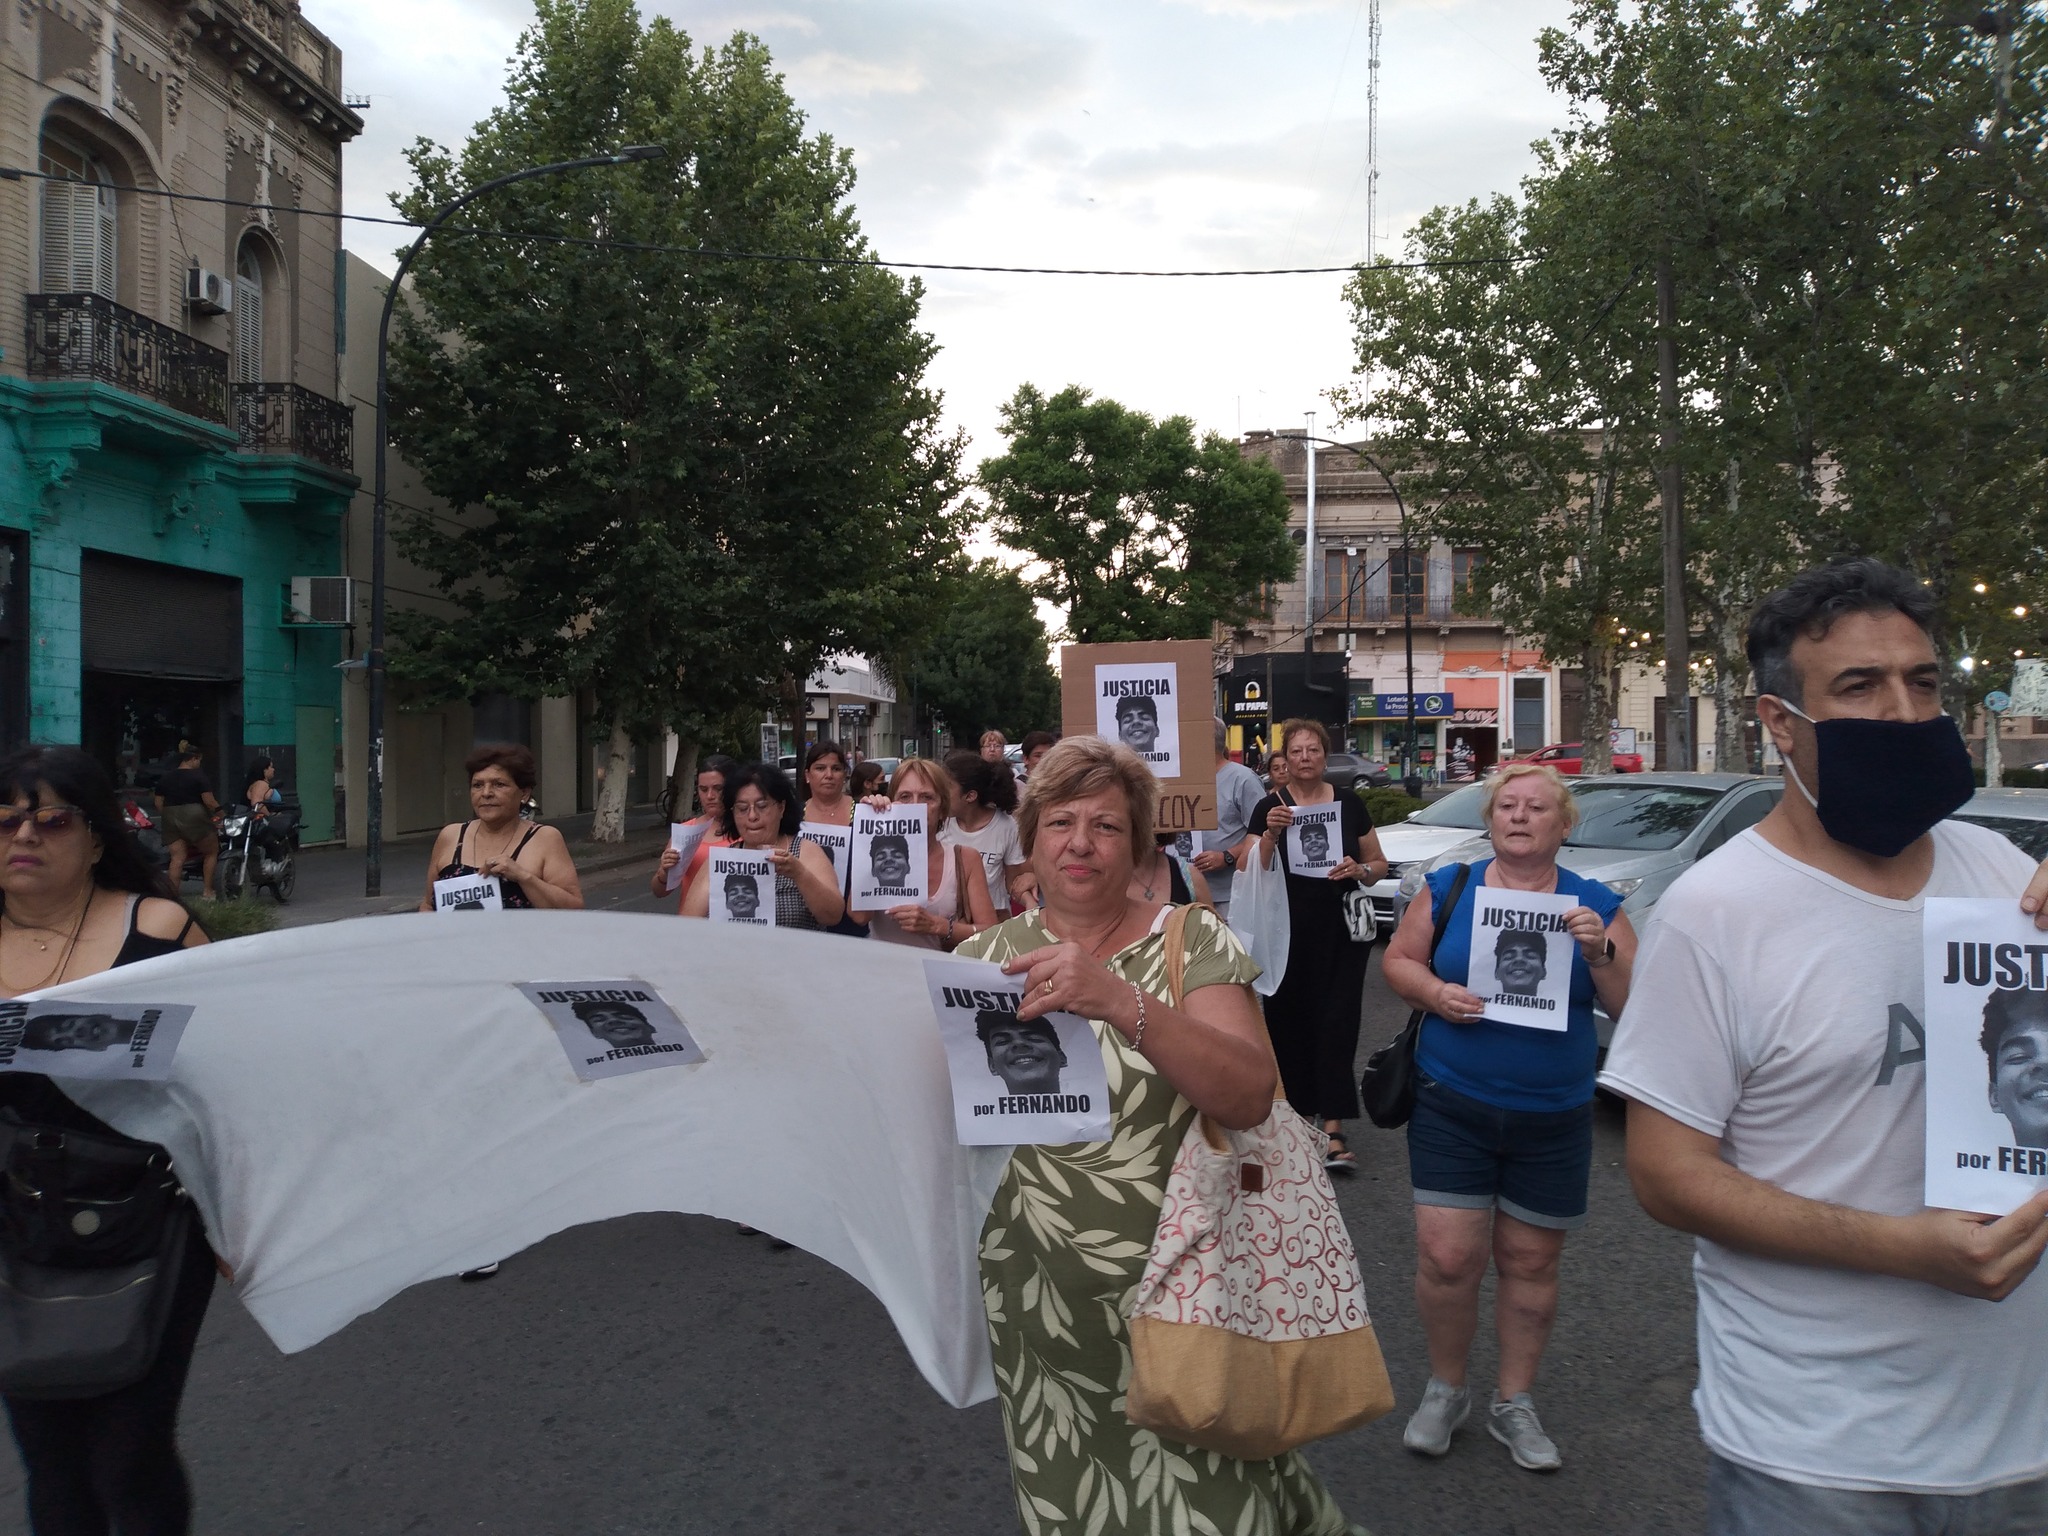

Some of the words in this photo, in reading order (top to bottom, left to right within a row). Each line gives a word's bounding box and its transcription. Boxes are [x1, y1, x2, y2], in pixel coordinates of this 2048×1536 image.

[1102, 679, 1171, 697] JUSTICIA
[1234, 702, 1246, 711] BY
[858, 819, 922, 836] JUSTICIA
[1291, 811, 1337, 826] JUSTICIA
[714, 860, 770, 876] JUSTICIA
[1304, 860, 1338, 868] FERNANDO
[441, 884, 495, 907] JUSTICIA
[861, 890, 872, 898] por
[874, 887, 919, 897] FERNANDO
[1481, 907, 1568, 933] JUSTICIA
[1943, 941, 2048, 989] JUST
[537, 989, 654, 1003] JUSTICIA
[942, 986, 1077, 1015] JUSTI
[1495, 993, 1556, 1011] FERNANDO
[129, 1009, 163, 1052] FERNANDO
[586, 1055, 605, 1065] por
[605, 1043, 684, 1061] FERNANDO
[973, 1104, 995, 1116] por
[998, 1094, 1091, 1115] FERNANDO
[1956, 1151, 1991, 1170] por
[1998, 1146, 2048, 1176] FER
